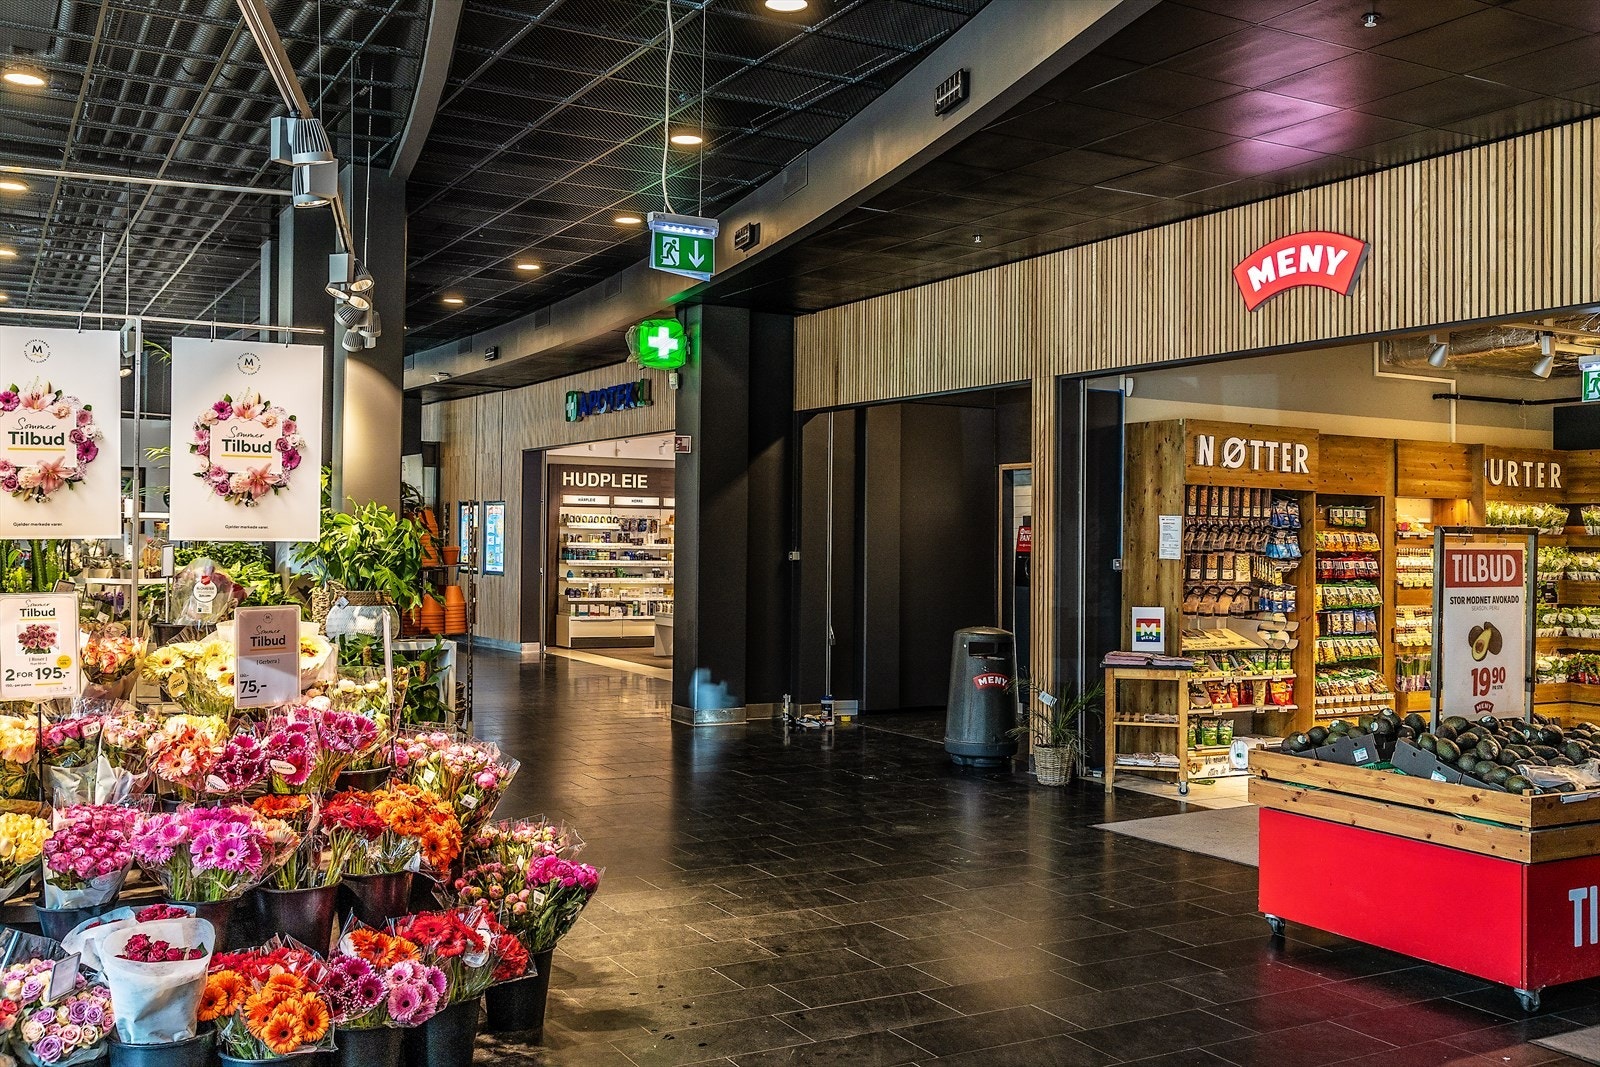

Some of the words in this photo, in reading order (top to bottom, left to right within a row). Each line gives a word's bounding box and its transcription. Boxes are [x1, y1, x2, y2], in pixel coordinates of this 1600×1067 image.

[1247, 244, 1349, 292] MENY
[577, 382, 635, 417] APOTEK
[12, 417, 56, 430] Sommer
[7, 431, 65, 446] Tilbud
[226, 425, 265, 438] Sommer
[221, 438, 272, 453] Tilbud
[562, 472, 648, 488] HUDPLEIE
[1484, 458, 1561, 488] URTER
[1451, 553, 1517, 583] TILBUD
[1449, 596, 1466, 605] STOR
[1466, 595, 1491, 604] MODNET
[1492, 595, 1520, 604] AVOKADO
[20, 607, 56, 617] Tilbud
[1140, 622, 1157, 636] M
[250, 635, 286, 647] Tilbud
[5, 668, 15, 681] 2
[35, 667, 70, 680] 195,-
[978, 676, 1008, 686] MENY
[240, 680, 267, 694] 75,-
[1476, 703, 1492, 711] MENY
